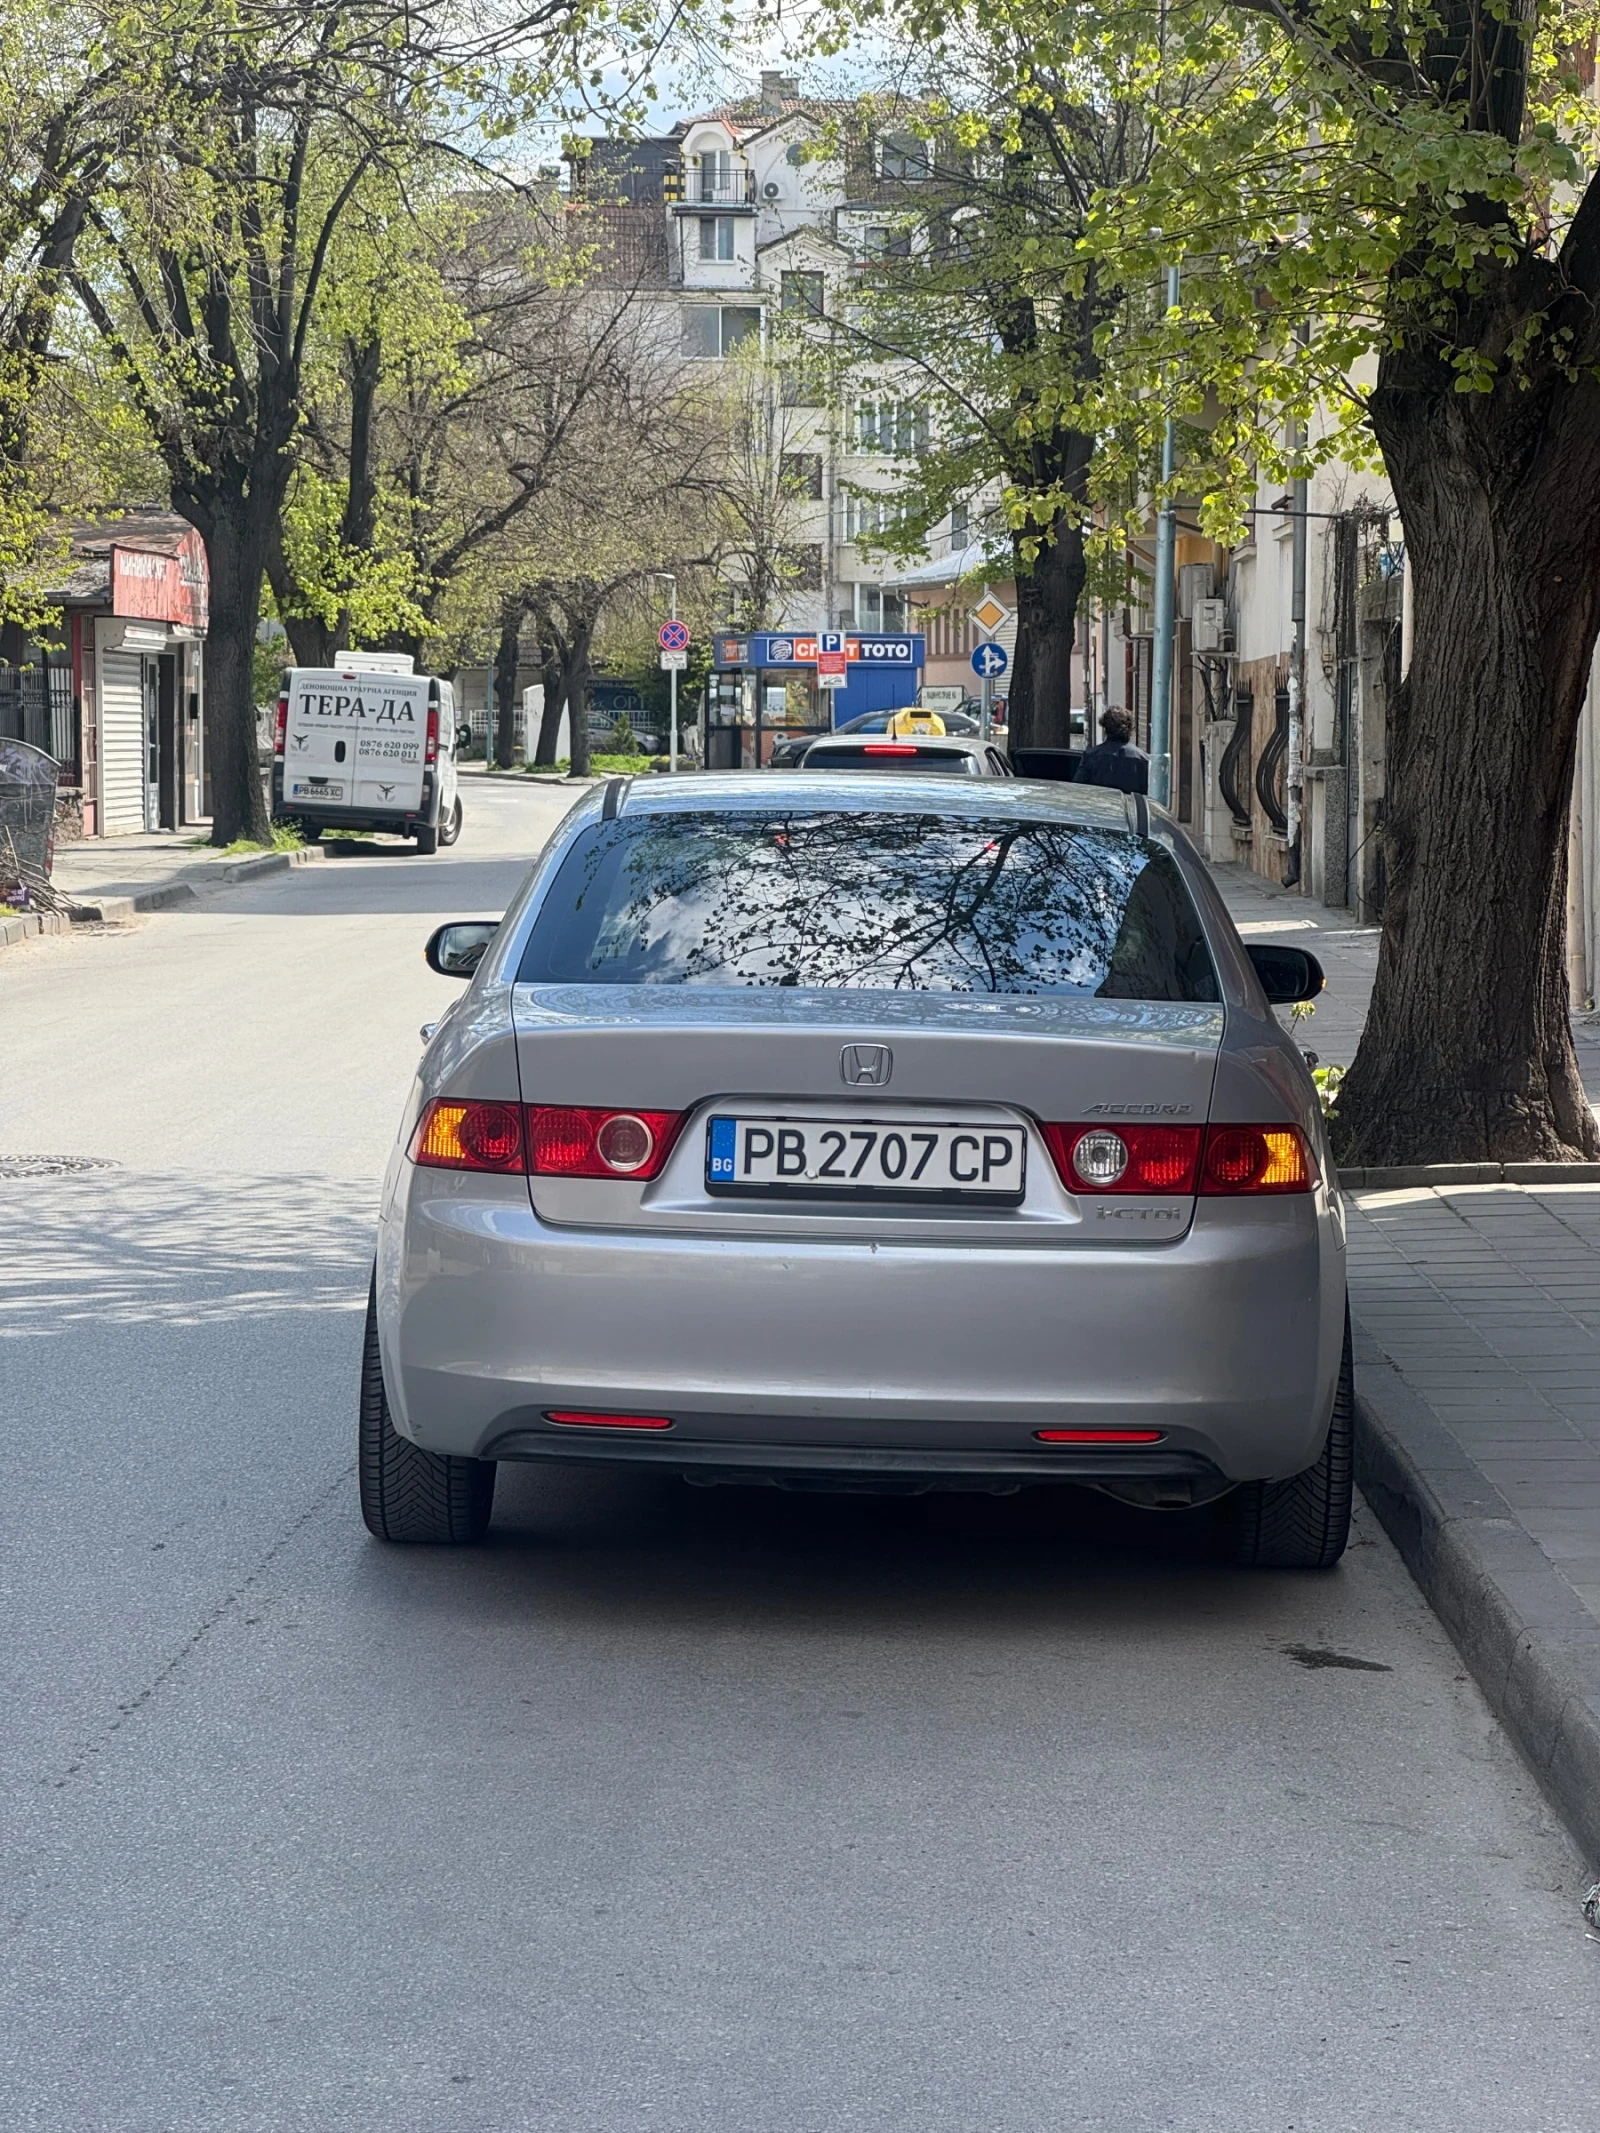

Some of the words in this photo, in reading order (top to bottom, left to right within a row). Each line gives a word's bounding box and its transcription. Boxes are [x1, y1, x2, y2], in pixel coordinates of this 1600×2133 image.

[796, 643, 857, 656] СПТ
[861, 643, 909, 657] ТОТО
[826, 635, 838, 651] P
[300, 683, 347, 692] ДЕНОНОЩНА
[348, 686, 382, 694] ТРАУРНА
[382, 688, 417, 697] АГЕНЦИЯ
[299, 693, 416, 725] ТЕРА-ДА
[360, 739, 383, 748] 0876
[384, 740, 401, 749] 620
[402, 741, 420, 750] 099
[359, 748, 382, 756] 0876
[382, 749, 400, 757] 620
[401, 750, 417, 759] 011
[299, 786, 309, 795] PB
[310, 786, 329, 796] 6665
[330, 787, 341, 797] XC
[1081, 1102, 1195, 1115] ACCORD
[743, 1127, 807, 1176] PB
[818, 1129, 939, 1181] 2707
[949, 1135, 1013, 1183] CP
[712, 1157, 733, 1173] BG
[1096, 1205, 1180, 1220] i-CTDi
